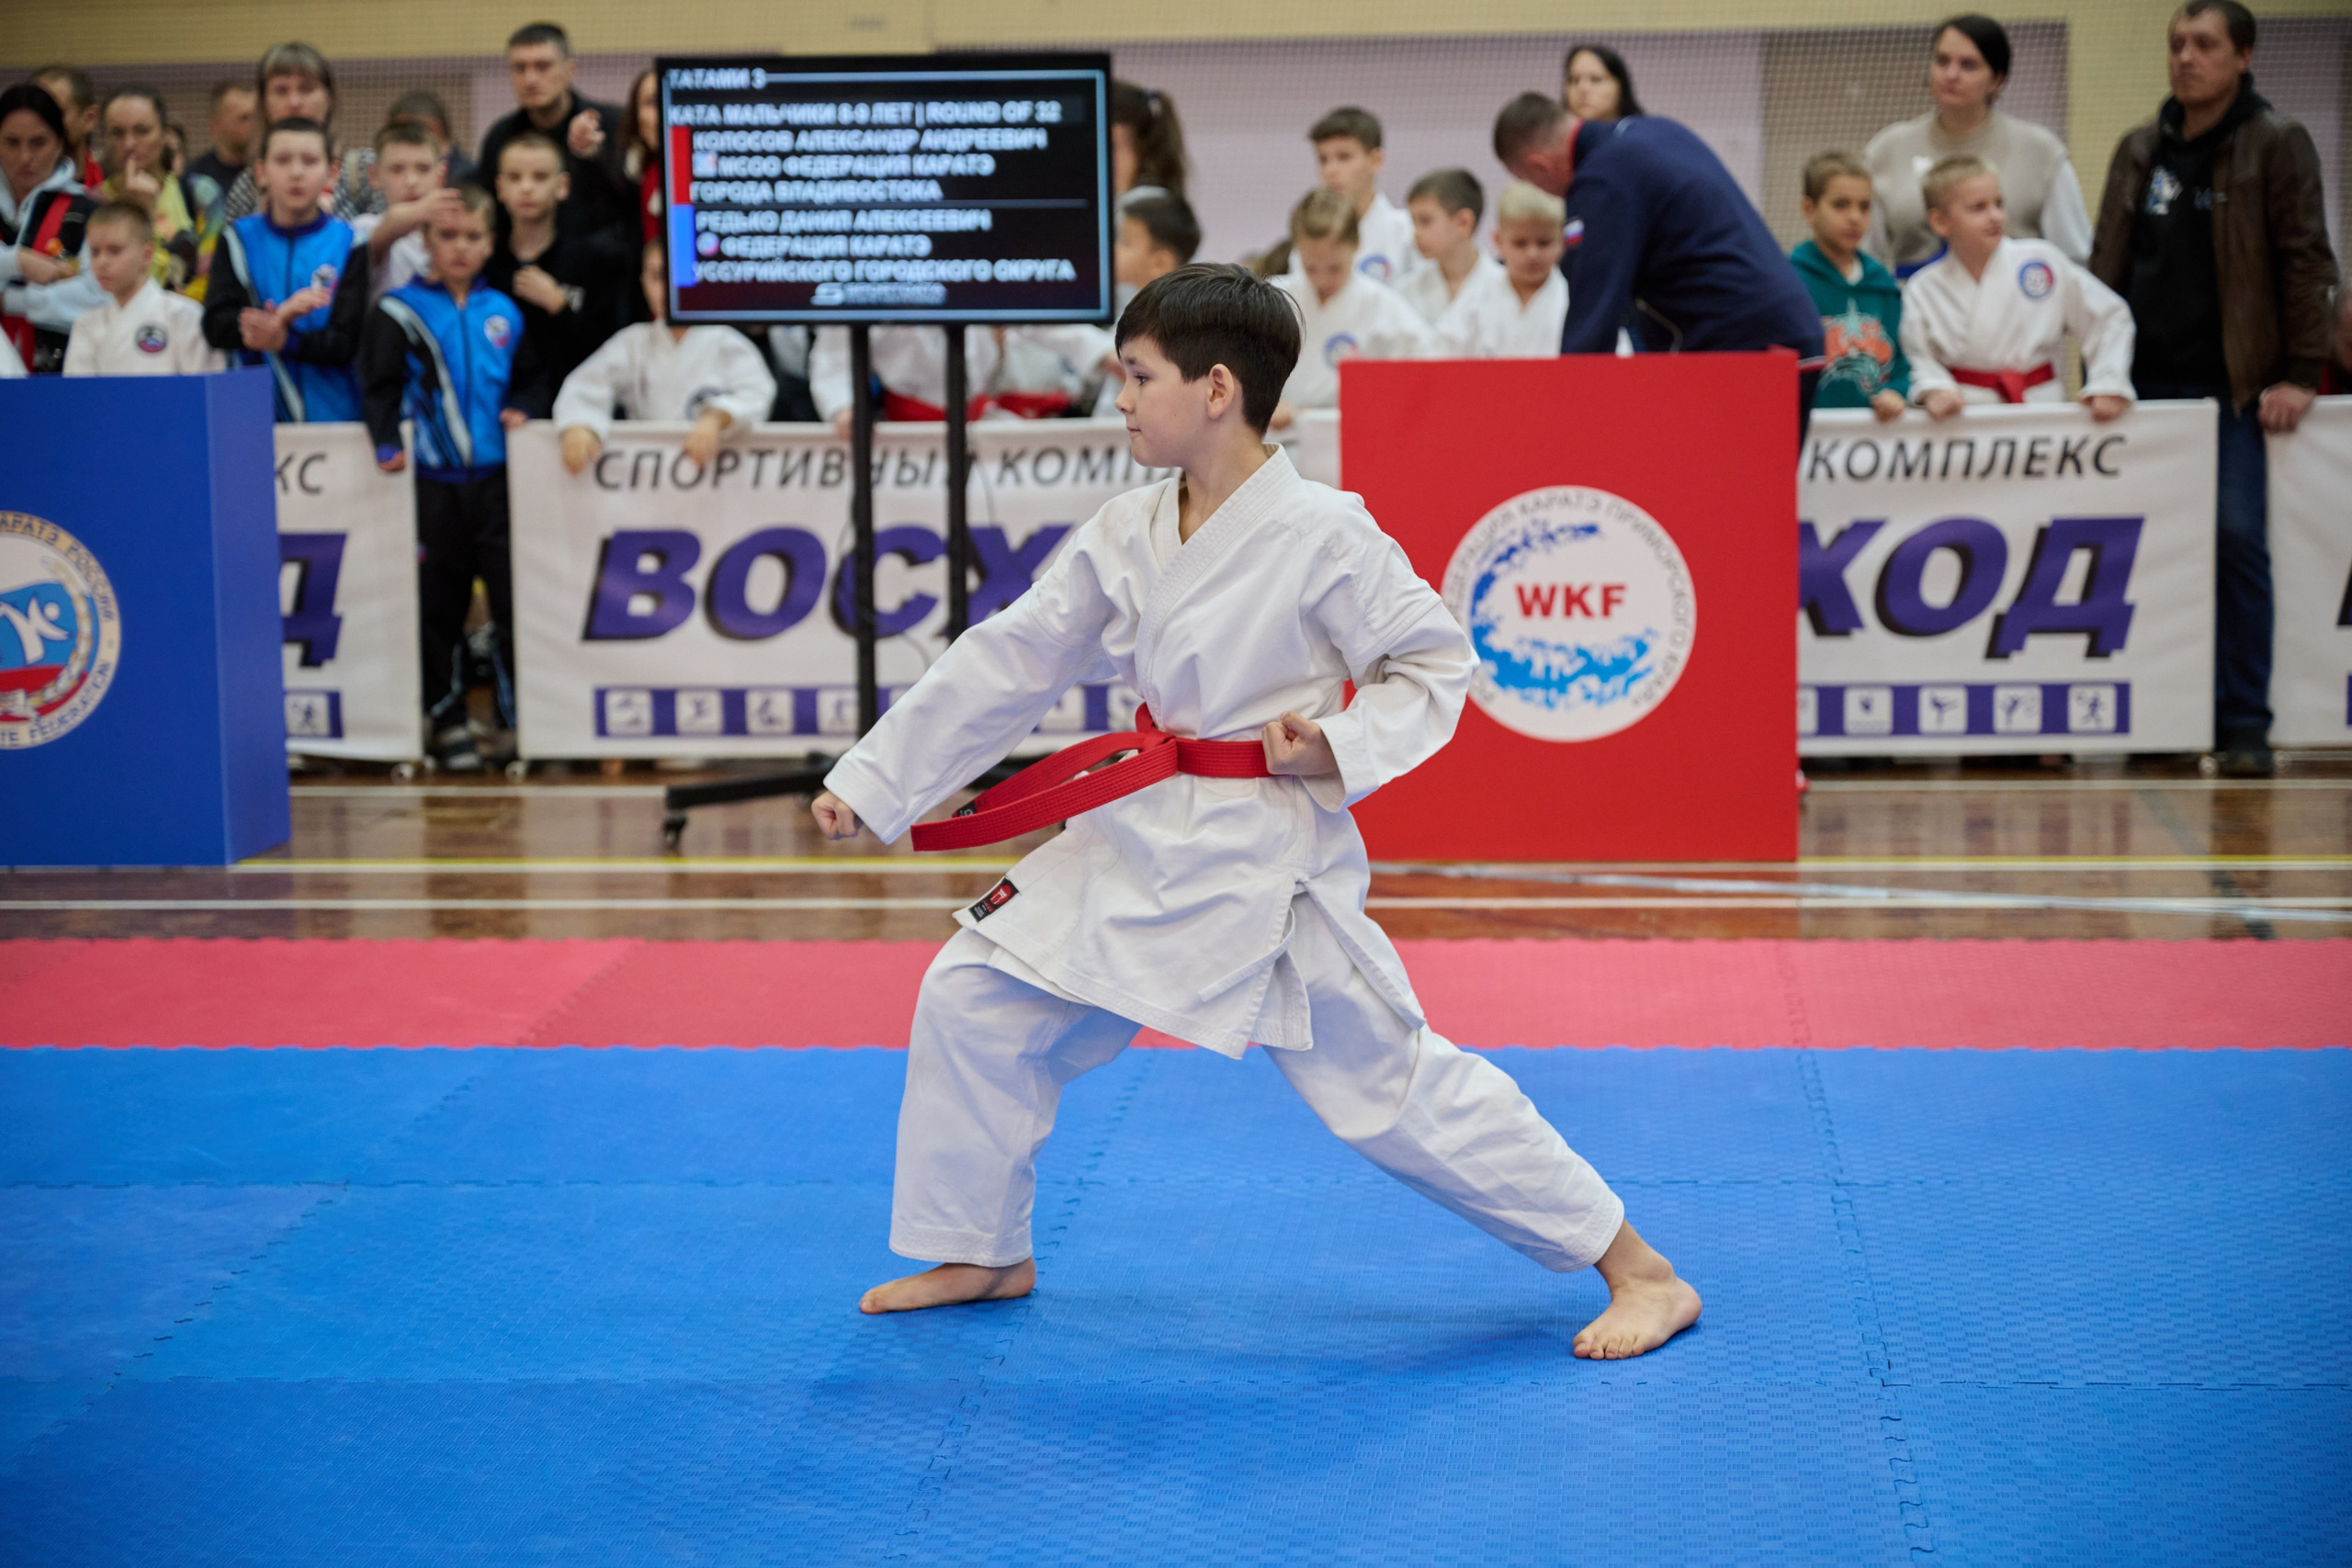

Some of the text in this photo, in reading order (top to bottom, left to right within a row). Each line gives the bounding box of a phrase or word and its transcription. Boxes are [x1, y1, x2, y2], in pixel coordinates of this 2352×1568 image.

[668, 67, 766, 89] ТАТАМИ 3
[669, 104, 722, 125] КАТА
[723, 103, 837, 125] МАЛЬЧИКИ
[870, 102, 915, 124] ЛЕТ
[926, 101, 1001, 124] ROUND
[1001, 100, 1034, 124] OF
[795, 129, 920, 153] АЛЕКСАНДР
[920, 128, 1047, 152] АНДРЕЕВИЧ
[782, 154, 911, 179] ФЕДЕРАЦИЯ
[912, 153, 995, 176] КАРАТЭ
[690, 179, 944, 204] ГОРОДА ВЛАДИВОСТОКА
[854, 209, 992, 232] АЛЕКСЕЕВИЧ
[720, 234, 932, 259] ФЕДЕРАЦИЯ КАРАТЭ
[854, 259, 993, 282] ГОРОДСКОГО
[993, 258, 1077, 282] ОКРУГА
[594, 446, 974, 491] СПОРТИВНЫ
[1809, 434, 2128, 481] КОМПЛЕКС
[1516, 583, 1626, 619] WKF
